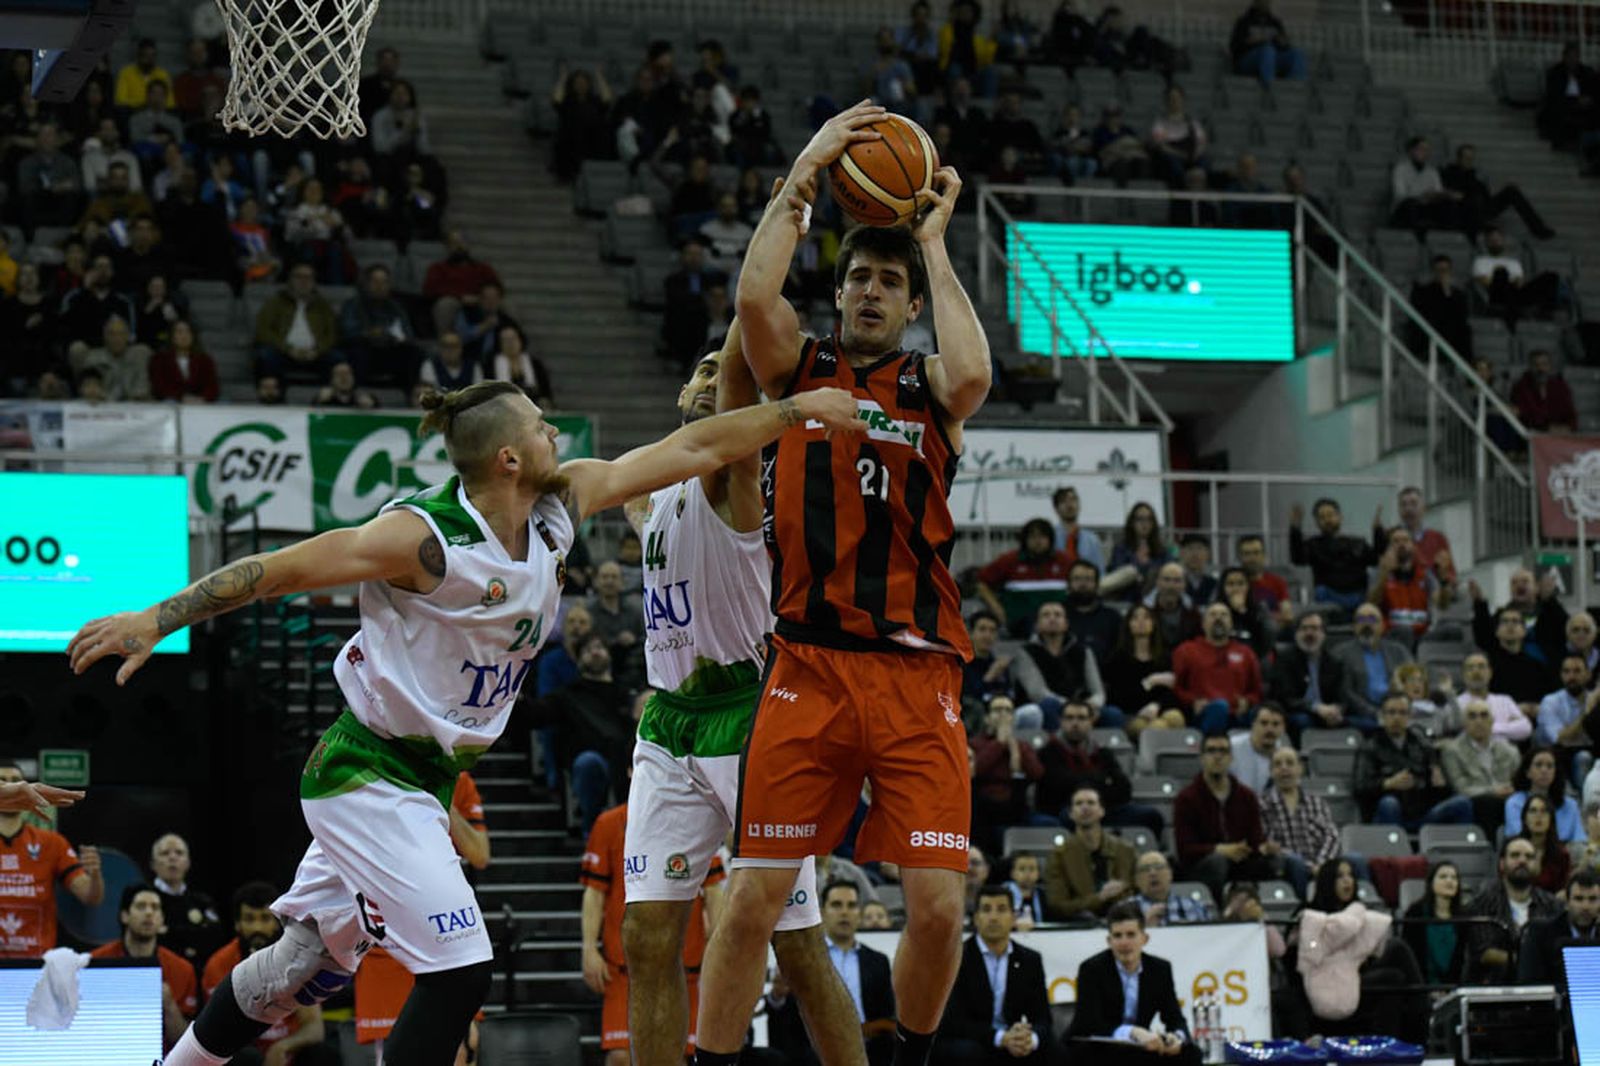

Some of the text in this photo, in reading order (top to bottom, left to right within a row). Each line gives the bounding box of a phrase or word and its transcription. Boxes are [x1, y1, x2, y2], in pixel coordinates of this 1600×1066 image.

[219, 448, 302, 482] CSIF
[856, 458, 889, 501] 21
[645, 530, 667, 572] 44
[644, 580, 692, 630] AU
[511, 614, 543, 652] 24
[763, 823, 817, 838] BERNER
[428, 907, 477, 934] TAU
